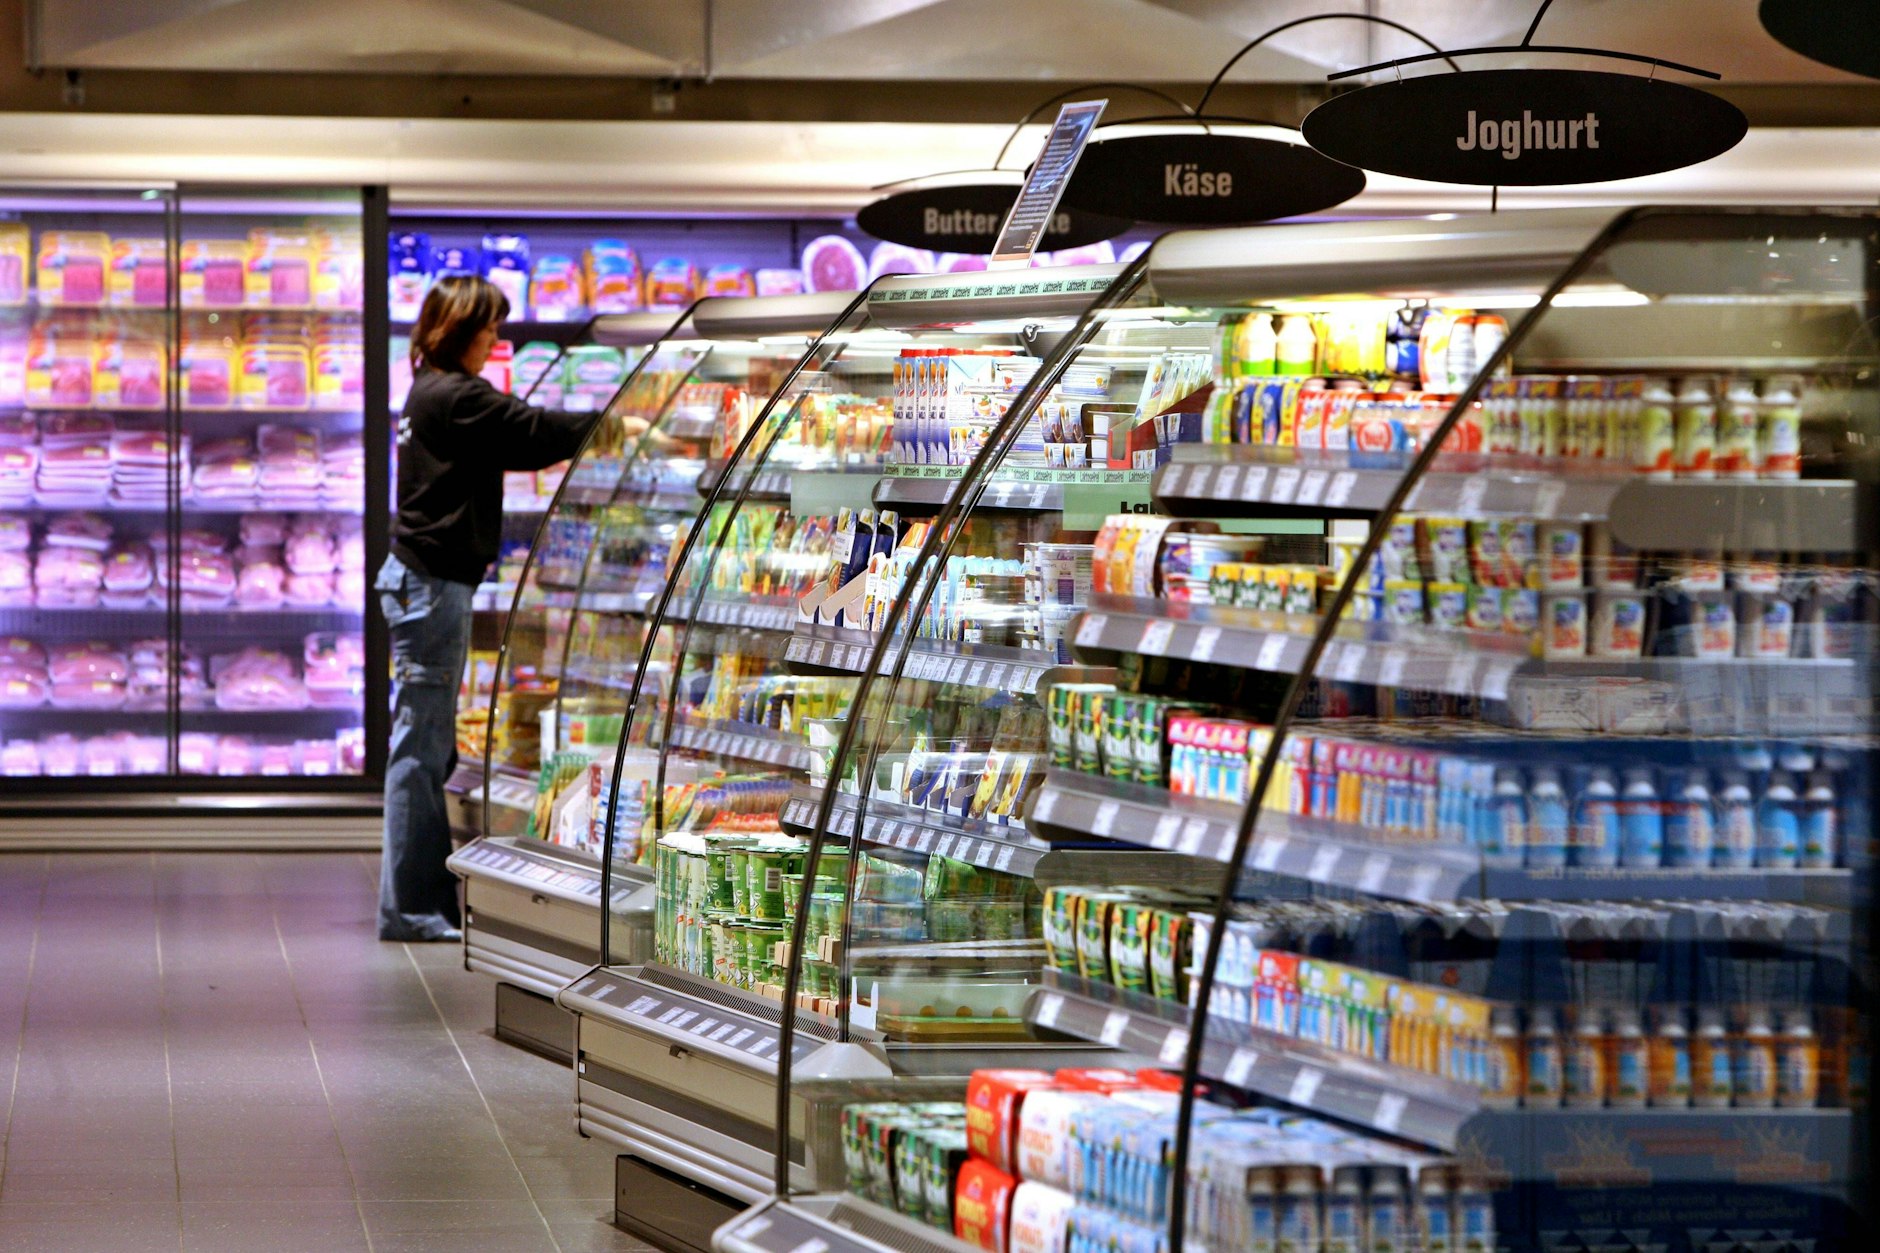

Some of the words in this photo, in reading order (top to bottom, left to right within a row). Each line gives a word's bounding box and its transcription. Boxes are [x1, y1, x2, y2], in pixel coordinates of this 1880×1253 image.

[1456, 110, 1600, 160] Joghurt
[1164, 163, 1232, 197] Käse
[923, 207, 999, 235] Butter
